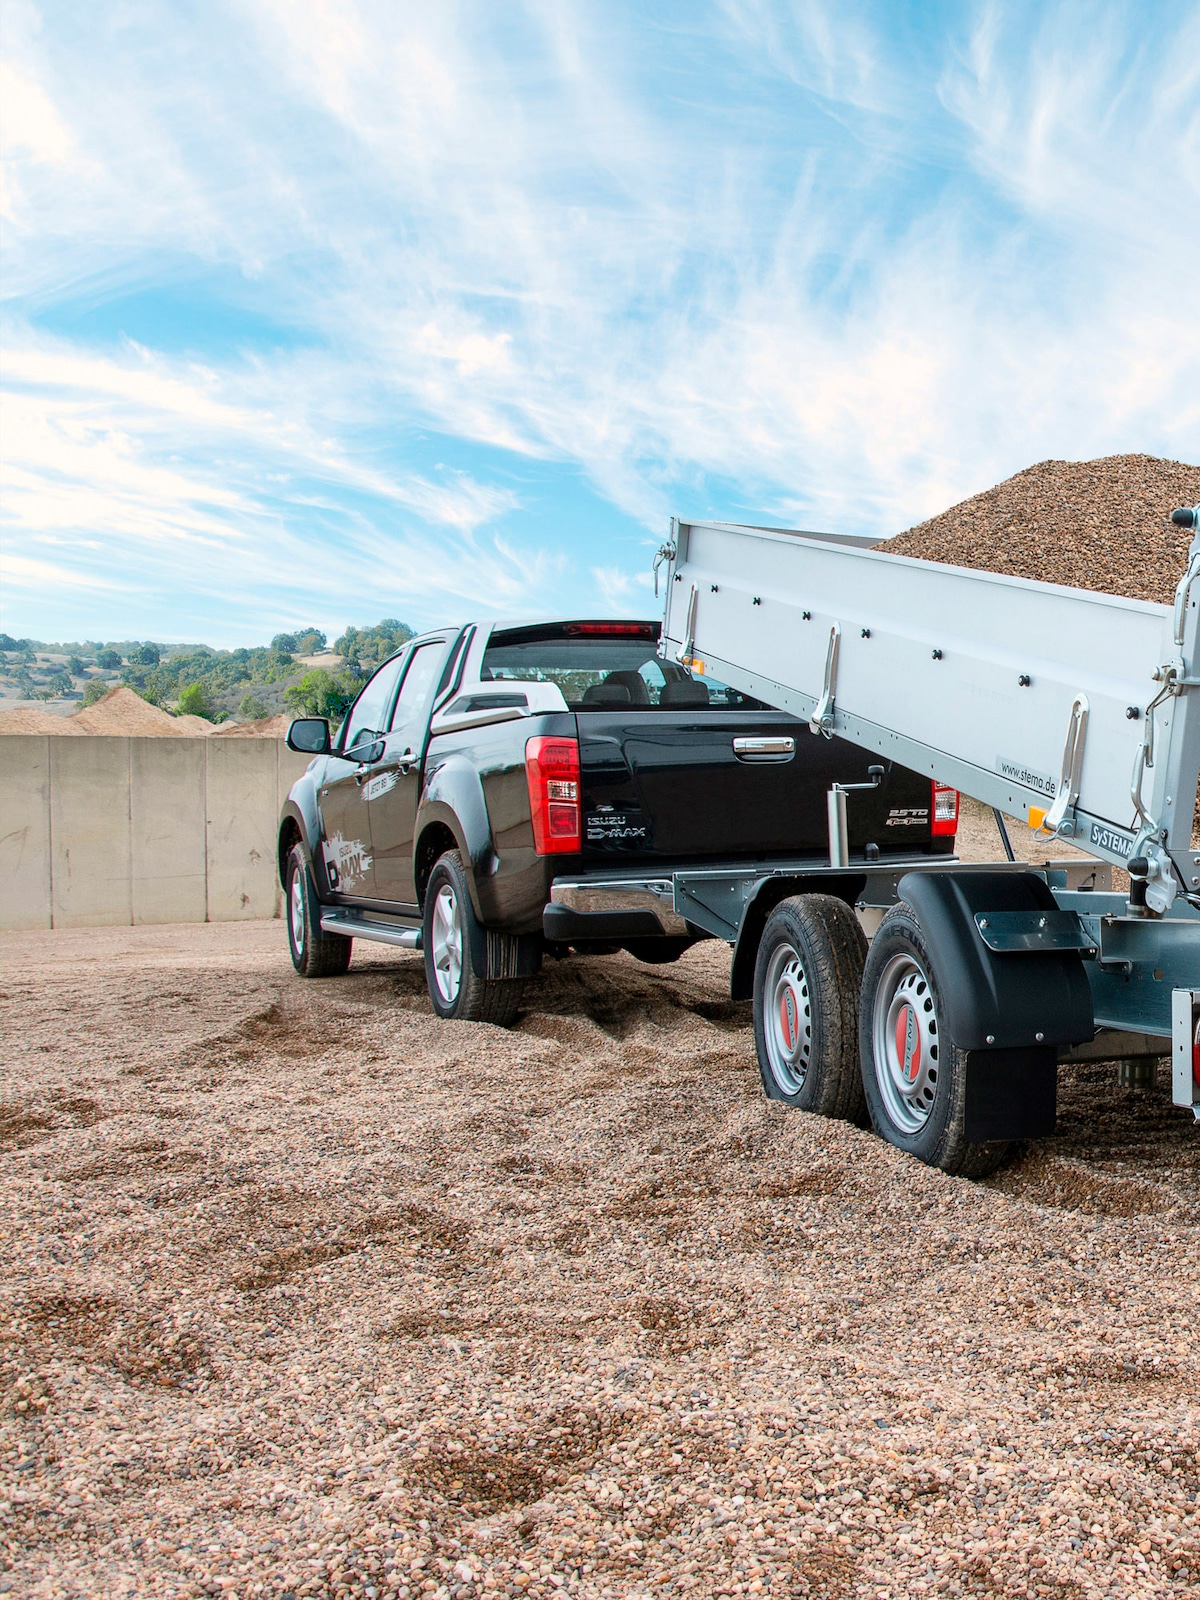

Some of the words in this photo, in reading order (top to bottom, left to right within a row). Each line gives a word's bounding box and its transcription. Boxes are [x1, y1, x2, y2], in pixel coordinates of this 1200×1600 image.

[1001, 763, 1056, 794] www.stema.de
[587, 816, 626, 826] ISUZU
[1091, 825, 1132, 856] SySTEMA
[904, 1008, 914, 1078] STEMA
